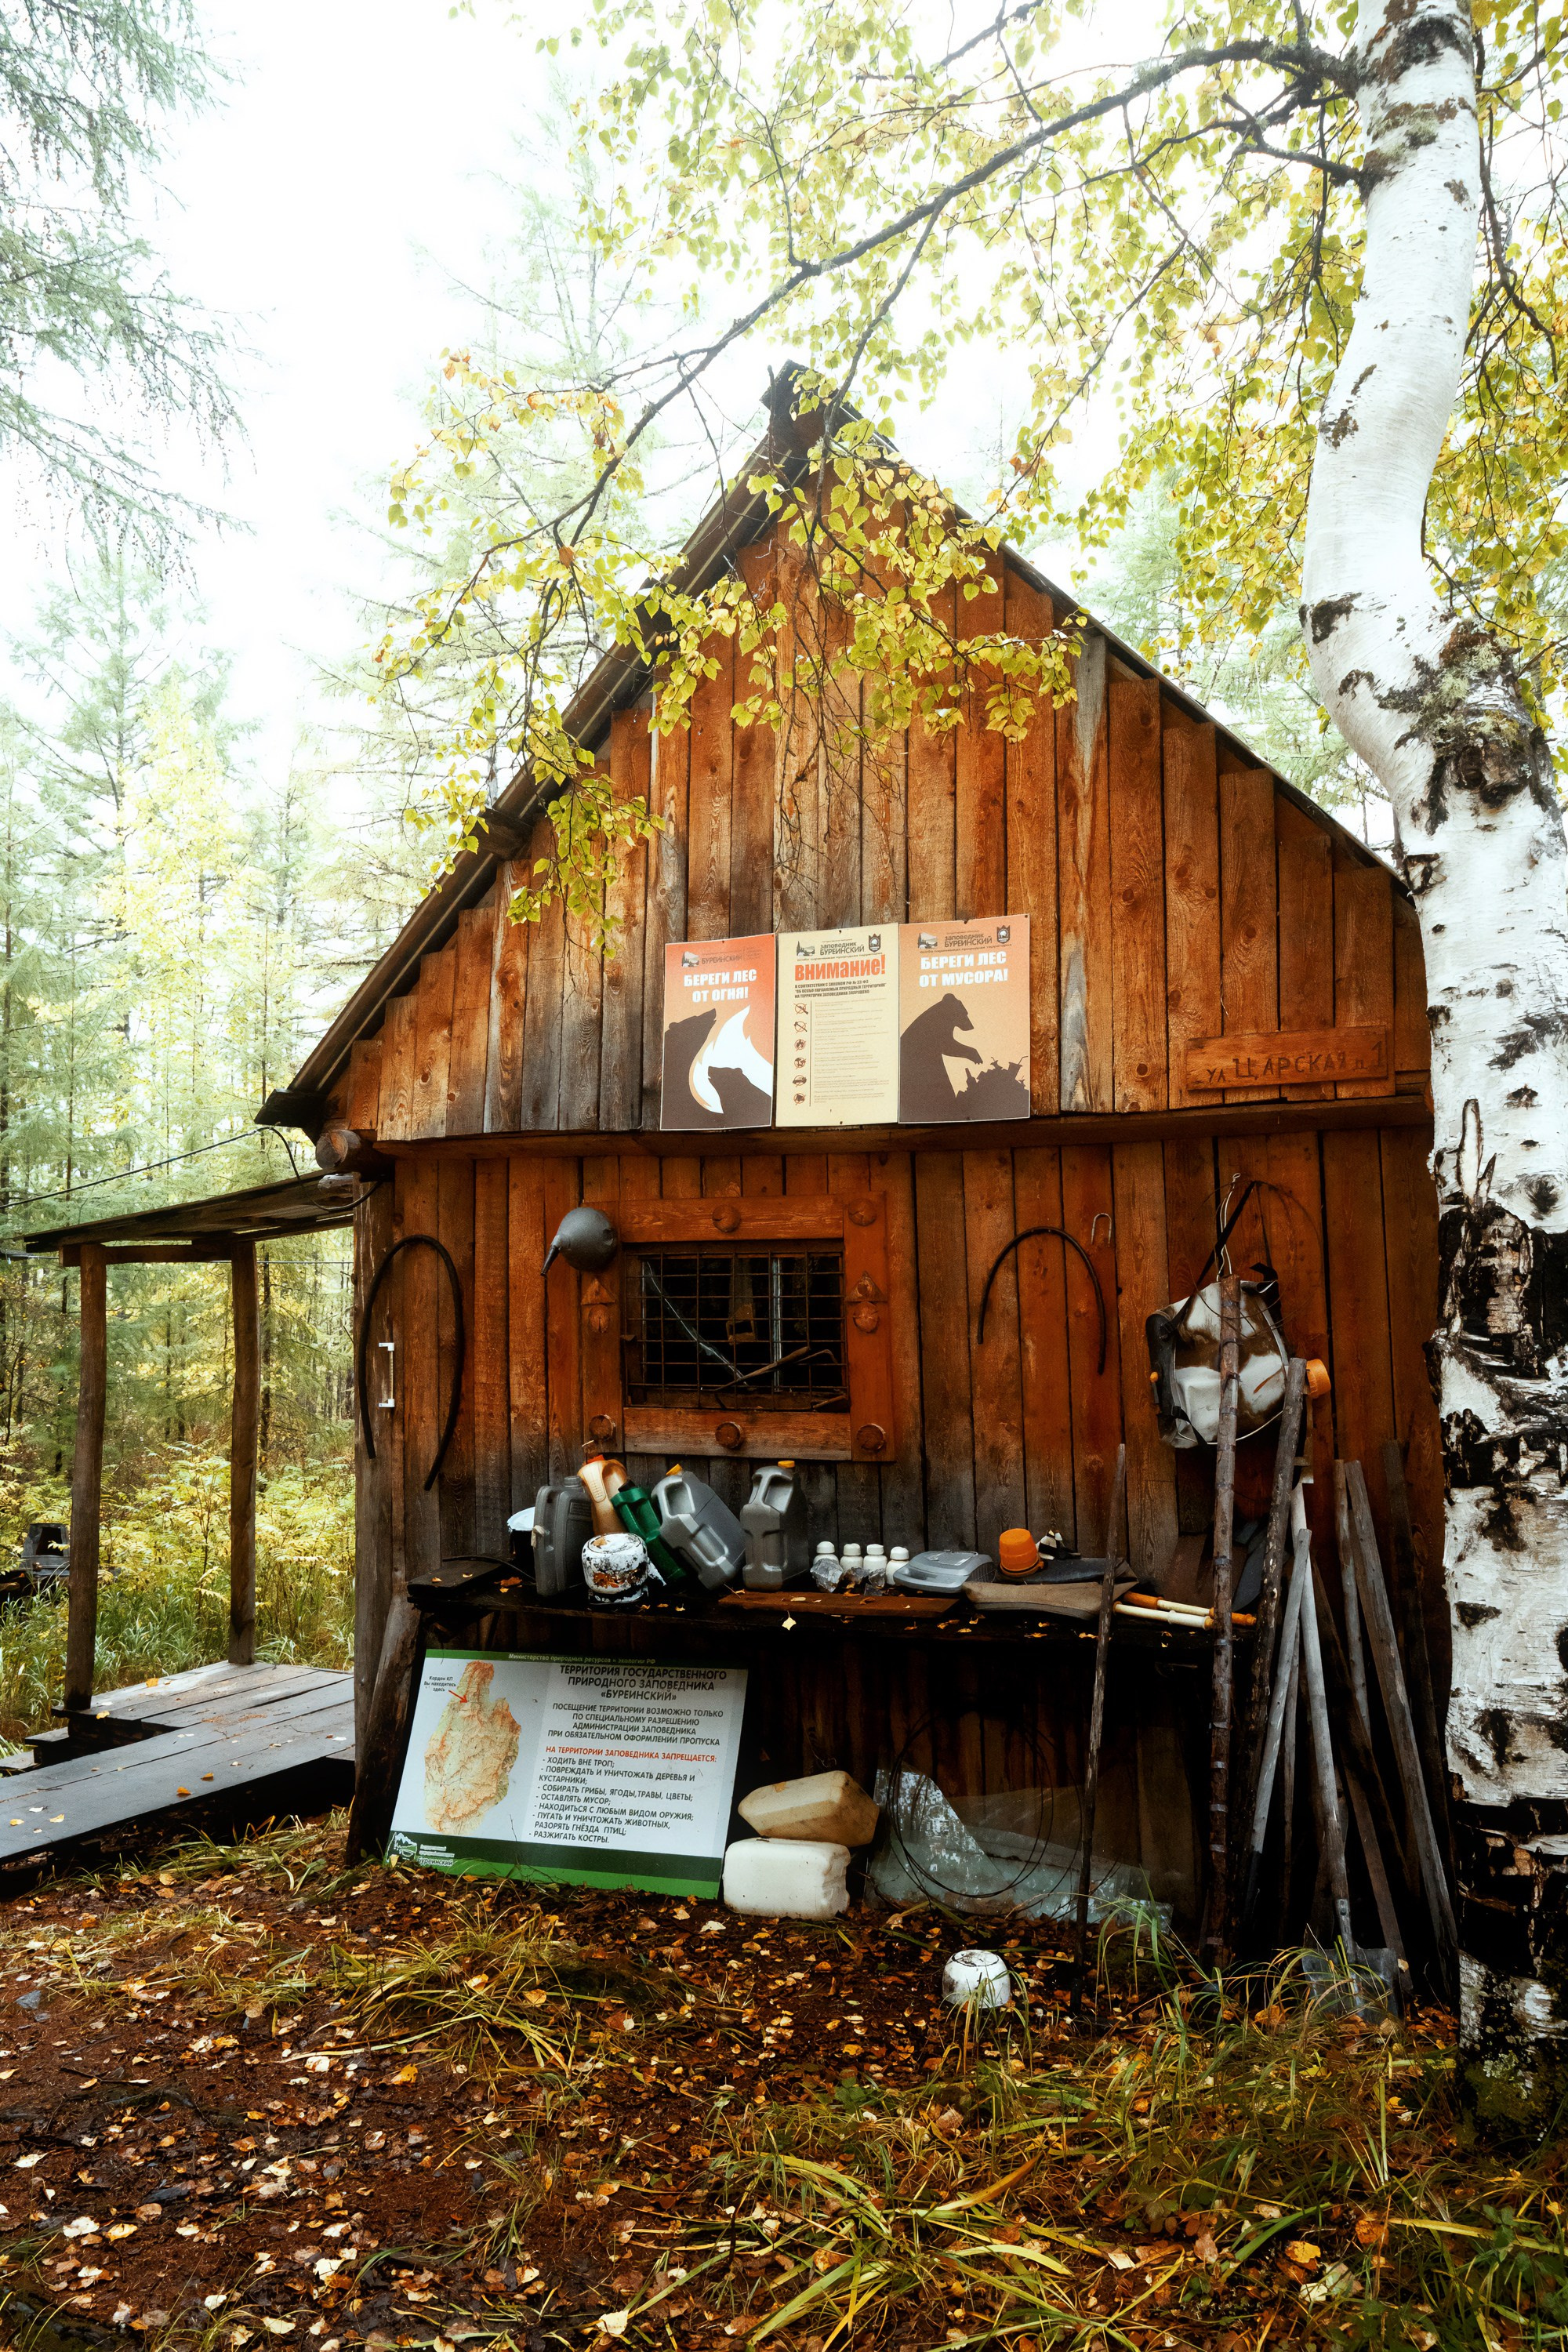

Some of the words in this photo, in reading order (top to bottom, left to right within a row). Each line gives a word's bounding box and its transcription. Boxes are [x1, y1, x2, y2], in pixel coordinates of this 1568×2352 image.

[945, 936, 993, 948] БУРЕИНСКИЙ
[820, 944, 865, 956] БУРЕИНСКИЙ
[920, 953, 974, 970] БЕРЕГИ
[977, 951, 1007, 966] ЛЕС
[684, 971, 730, 987] БЕРЕГИ
[732, 969, 757, 983] ЛЕС
[919, 974, 938, 988] ОТ
[942, 968, 1008, 986] МУСОРА!
[692, 990, 709, 1003] ОТ
[712, 986, 749, 1001] ОГНЯ!
[1232, 1051, 1346, 1080] ЦАРСКАЯ
[561, 1665, 619, 1676] ТЕРРИТОРИЯ
[623, 1667, 727, 1680] ГОСУДАРСТВЕННОГО
[568, 1677, 636, 1688] ПРИРОДНОГО
[639, 1679, 714, 1691] ЗАПОВЕДНИКА
[601, 1689, 677, 1701] «БУРЕИНСКИЙ»
[553, 1703, 597, 1712] ПОСЕЩЕНИЕ
[599, 1705, 644, 1715] ТЕРРИТОРИИ
[646, 1707, 691, 1716] ВОЗМОЖНО
[694, 1709, 724, 1718] ТОЛЬКО
[585, 1714, 646, 1724] СПЕЦИАЛЬНОМУ
[648, 1717, 699, 1726] РАЗРЕШЕНИЮ
[572, 1722, 639, 1733] АДМИНИСТРАЦИИ
[641, 1726, 696, 1735] ЗАПОВЕДНИКА
[565, 1731, 622, 1740] ОБЯЗАТЕЛЬНОМ
[623, 1733, 677, 1744] ОФОРМЛЕНИИ
[680, 1737, 720, 1746] ПРОПУСКА
[558, 1747, 603, 1756] ТЕРРИТОРИИ
[605, 1749, 659, 1759] ЗАПОВЕДНИКА
[662, 1752, 717, 1762] ЗАПРЕЩАЕТСЯ:
[594, 1759, 615, 1768] ТРОП;
[539, 1775, 587, 1784] КУСТАРНИКИ;
[546, 1766, 594, 1775] ПОВРЕЖДАТЬ
[604, 1769, 654, 1779] УНИЧТОЖАТЬ
[655, 1773, 687, 1781] ДЕРЕВЬЯ
[541, 1793, 581, 1802] ОСТАВЛЯТЬ
[583, 1797, 611, 1806] МУСОР;
[543, 1784, 579, 1793] СОБИРАТЬ
[581, 1787, 607, 1795] ГРИБЫ,
[666, 1792, 693, 1802] ЦВЕТЫ;
[539, 1803, 587, 1813] НАХОДИТЬСЯ
[596, 1806, 626, 1816] ЛЮБЫМ
[629, 1809, 657, 1818] ВИДОМ
[659, 1811, 694, 1821] ОРУЖИЯ;
[535, 1821, 570, 1831] РАЗОРЯТЬ
[572, 1823, 599, 1833] ГНЁЗДА
[604, 1827, 626, 1836] ПТИЦ;
[537, 1812, 563, 1820] ПУГАТЬ
[572, 1815, 622, 1825] УНИЧТОЖАТЬ
[624, 1818, 670, 1830] ЖИВОТНЫХ,
[533, 1831, 576, 1841] РАЗЖИГАТЬ
[578, 1834, 609, 1843] КОСТРЫ.
